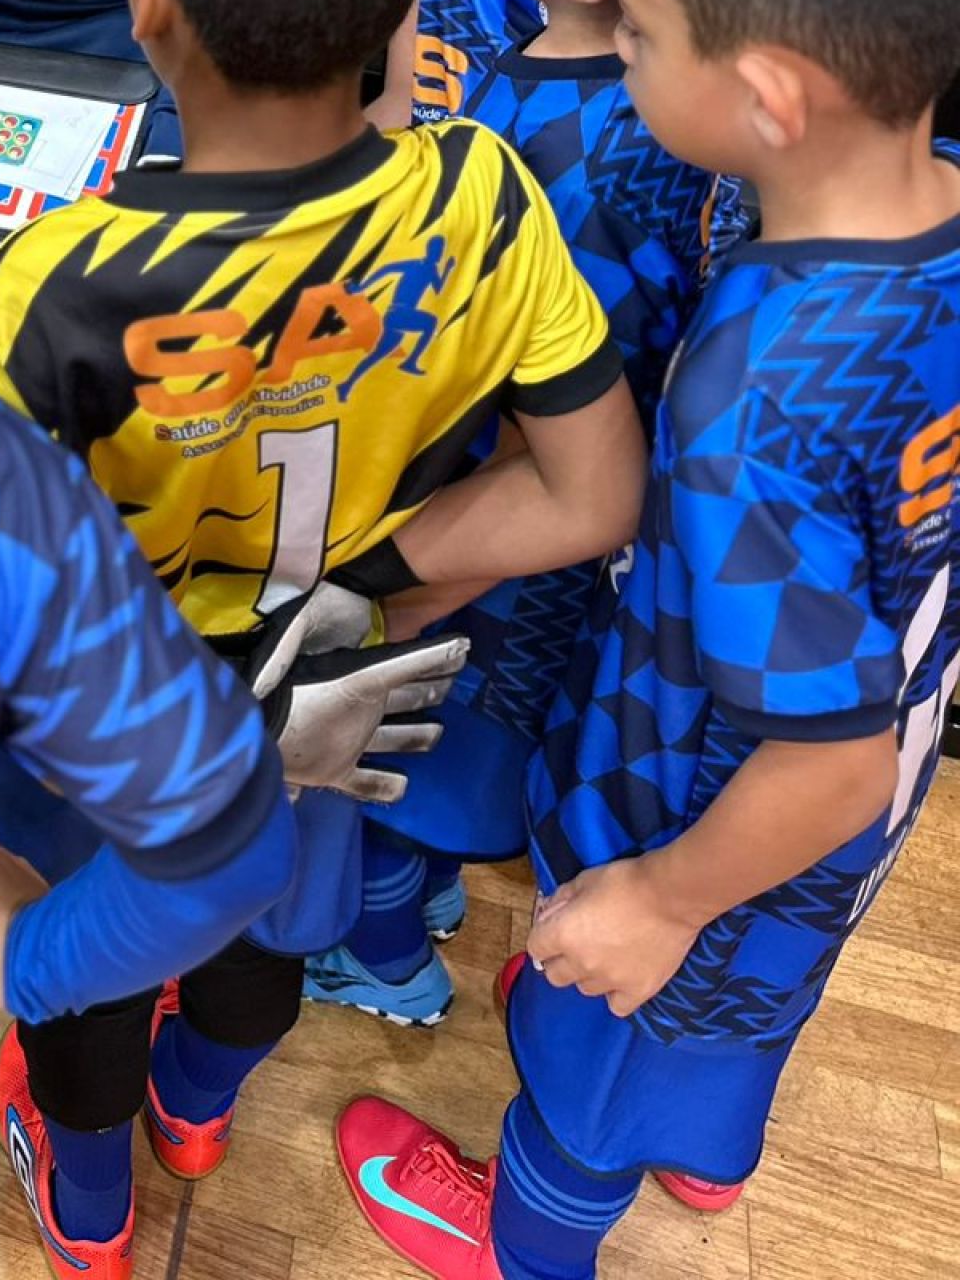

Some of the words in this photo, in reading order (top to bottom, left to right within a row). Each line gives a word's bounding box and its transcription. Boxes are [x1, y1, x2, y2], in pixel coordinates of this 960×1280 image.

[123, 279, 406, 418] SA
[155, 418, 221, 441] Saúde
[255, 419, 339, 616] 1
